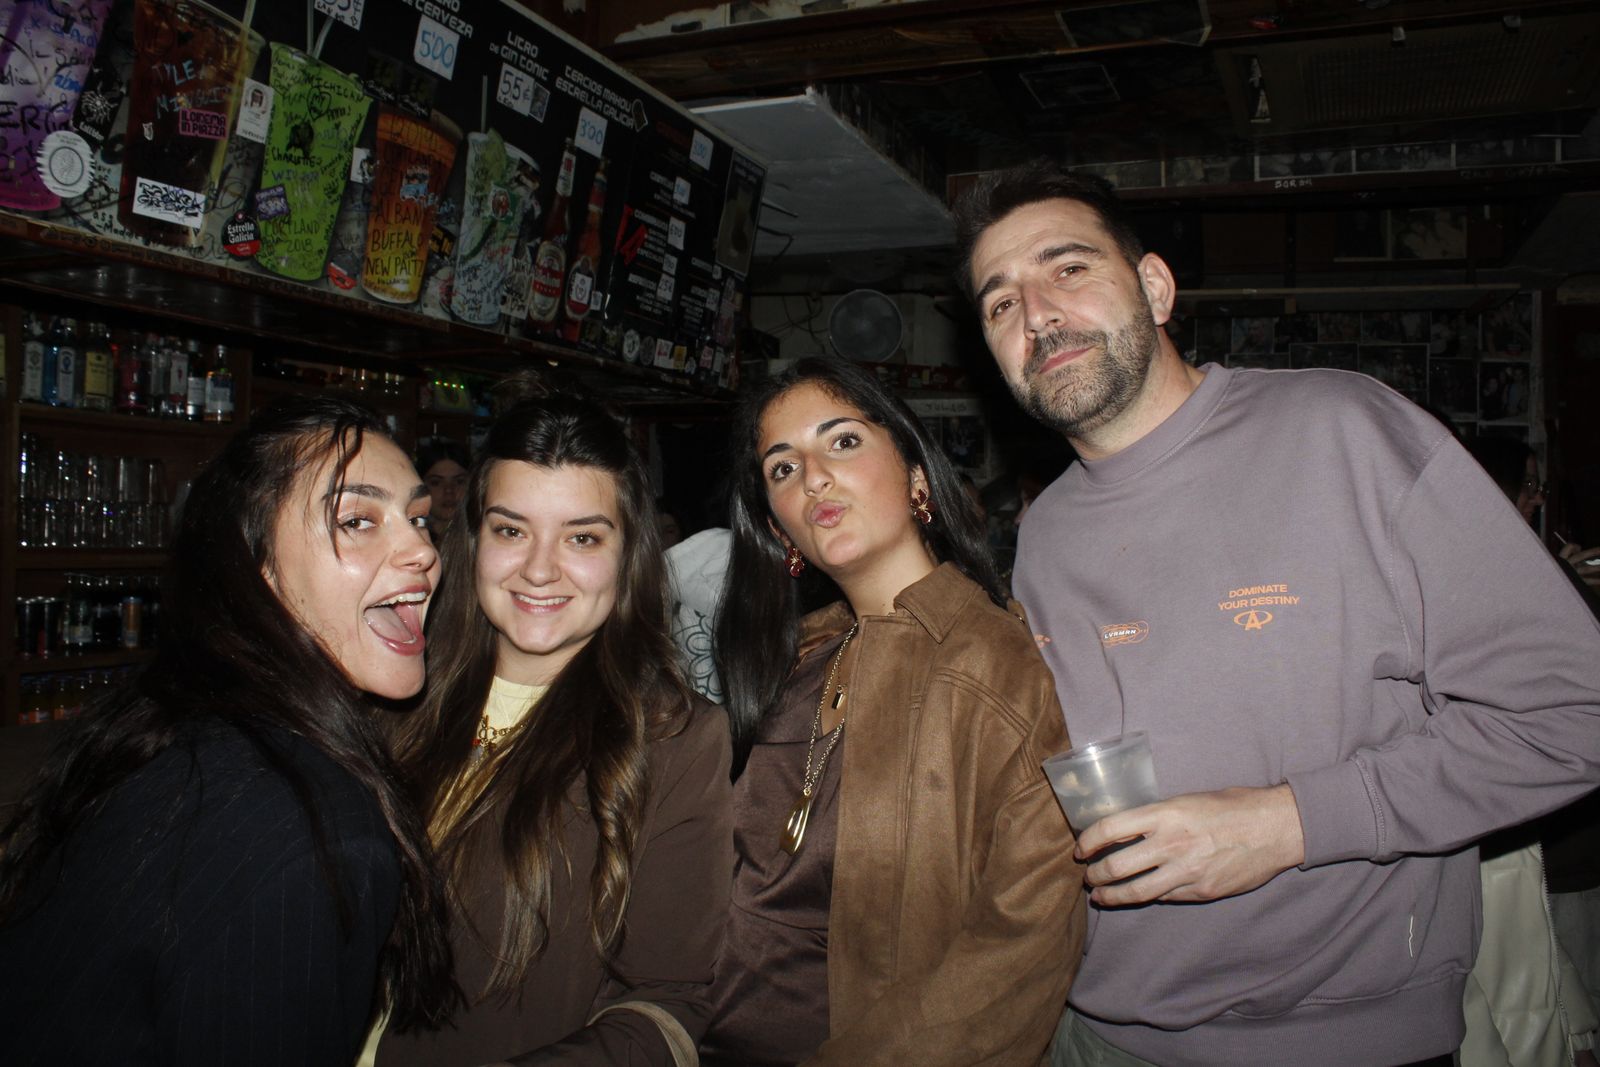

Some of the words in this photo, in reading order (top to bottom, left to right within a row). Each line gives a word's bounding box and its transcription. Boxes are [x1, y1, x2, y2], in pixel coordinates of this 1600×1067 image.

[501, 45, 517, 63] GIN
[564, 66, 602, 95] TERCIOS
[603, 87, 632, 112] MAHOU
[556, 76, 602, 110] ESTRELLA
[603, 103, 634, 129] GALICIA
[192, 122, 226, 137] PIAZZA
[227, 222, 255, 235] Estrella
[229, 232, 254, 244] Galicia
[365, 257, 391, 277] NEW
[1228, 584, 1288, 599] DOMINATE
[1217, 599, 1249, 611] YOUR
[1250, 595, 1300, 607] DESTINY
